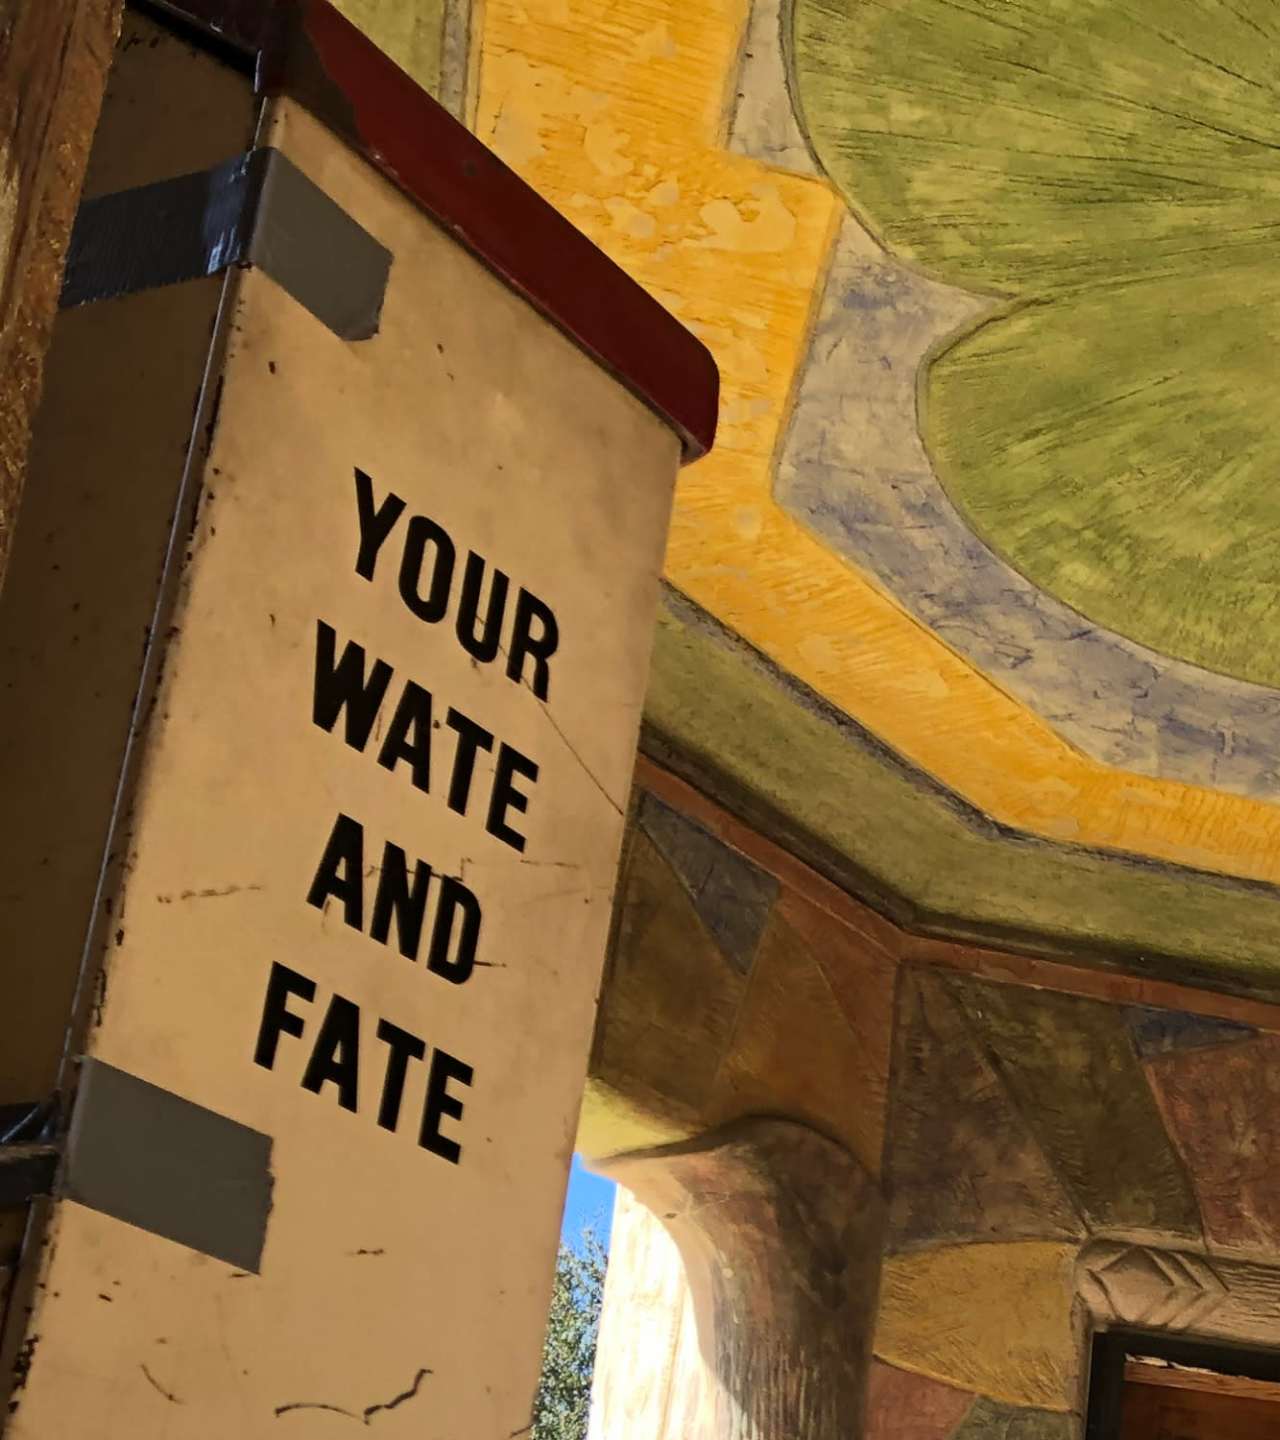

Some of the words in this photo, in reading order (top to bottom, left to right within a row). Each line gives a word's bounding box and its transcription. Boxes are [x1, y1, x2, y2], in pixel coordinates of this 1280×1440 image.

[353, 465, 561, 703] YOUR
[311, 618, 541, 855] WATE
[305, 811, 485, 986] AND
[253, 960, 476, 1165] FATE
